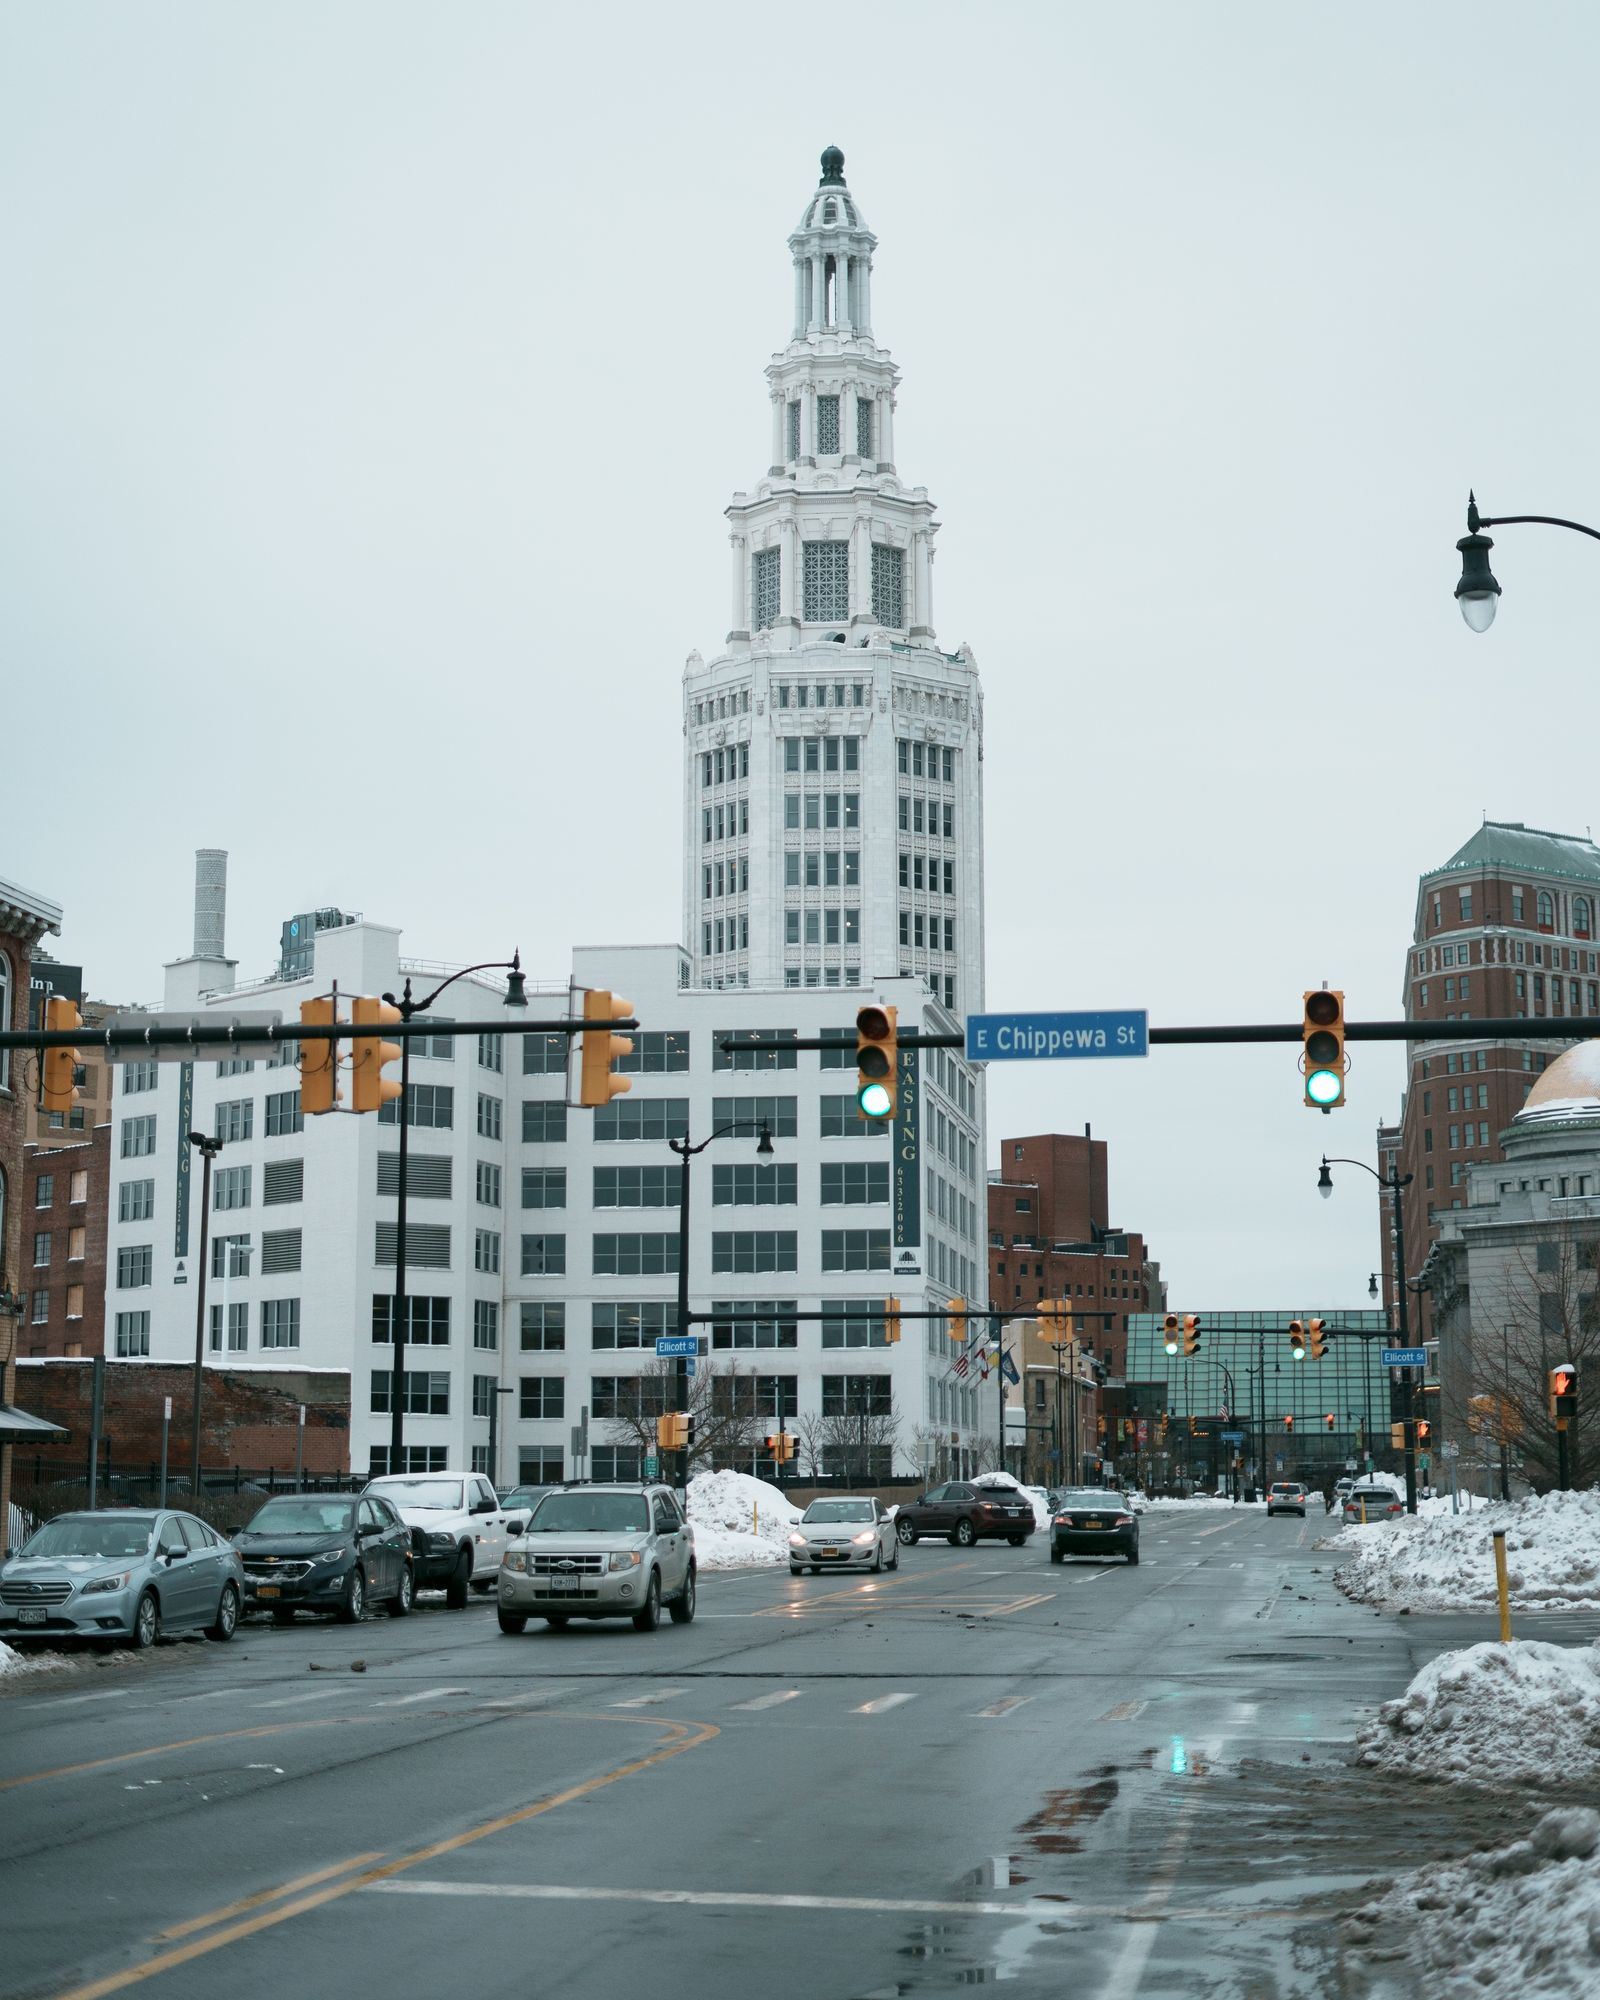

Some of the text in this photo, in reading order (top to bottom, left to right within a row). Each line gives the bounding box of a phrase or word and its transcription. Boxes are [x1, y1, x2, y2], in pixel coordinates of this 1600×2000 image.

[30, 976, 54, 990] Inn
[977, 1026, 1136, 1056] E Chippewa St
[181, 1061, 192, 1173] EASING
[902, 1052, 917, 1160] EASING
[659, 1341, 696, 1352] Ellicott St
[1384, 1352, 1424, 1362] Ellicott St
